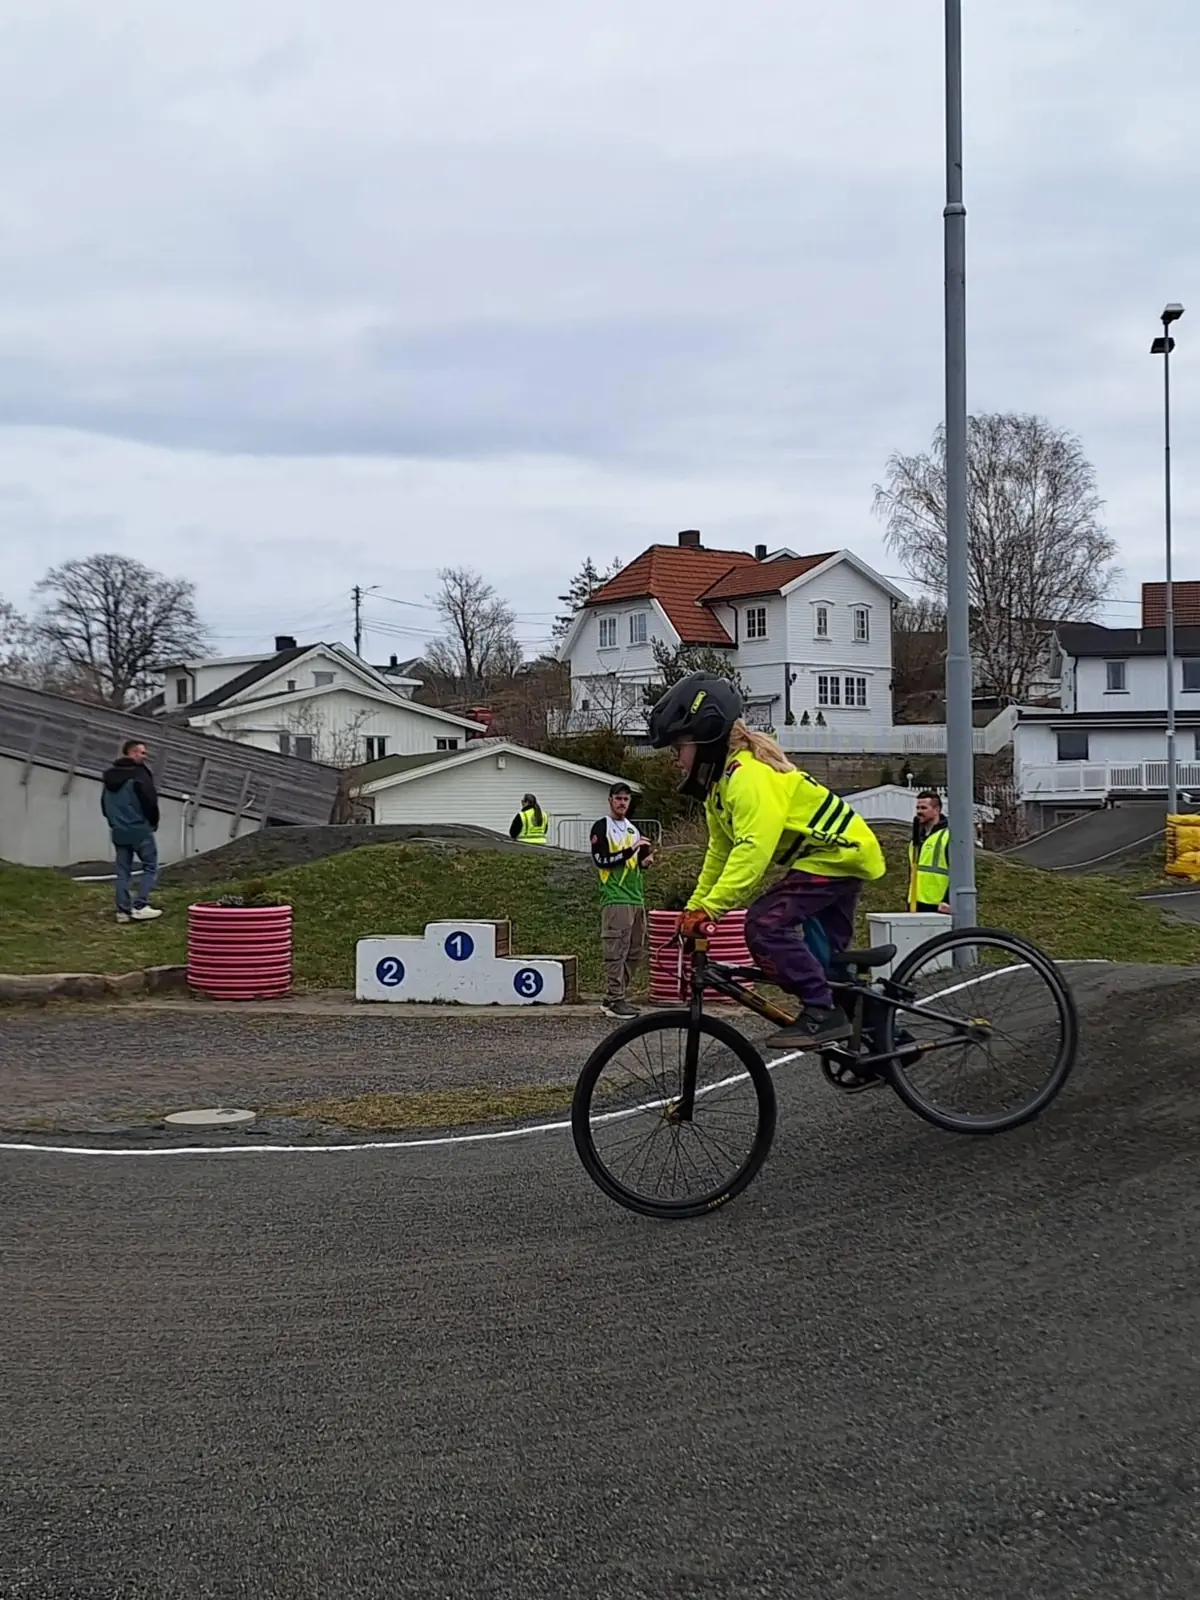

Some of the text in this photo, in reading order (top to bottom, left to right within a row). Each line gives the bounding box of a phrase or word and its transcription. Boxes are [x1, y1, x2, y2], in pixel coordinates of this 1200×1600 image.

[450, 935, 462, 957] 1
[383, 961, 398, 983] 2
[521, 972, 536, 994] 3
